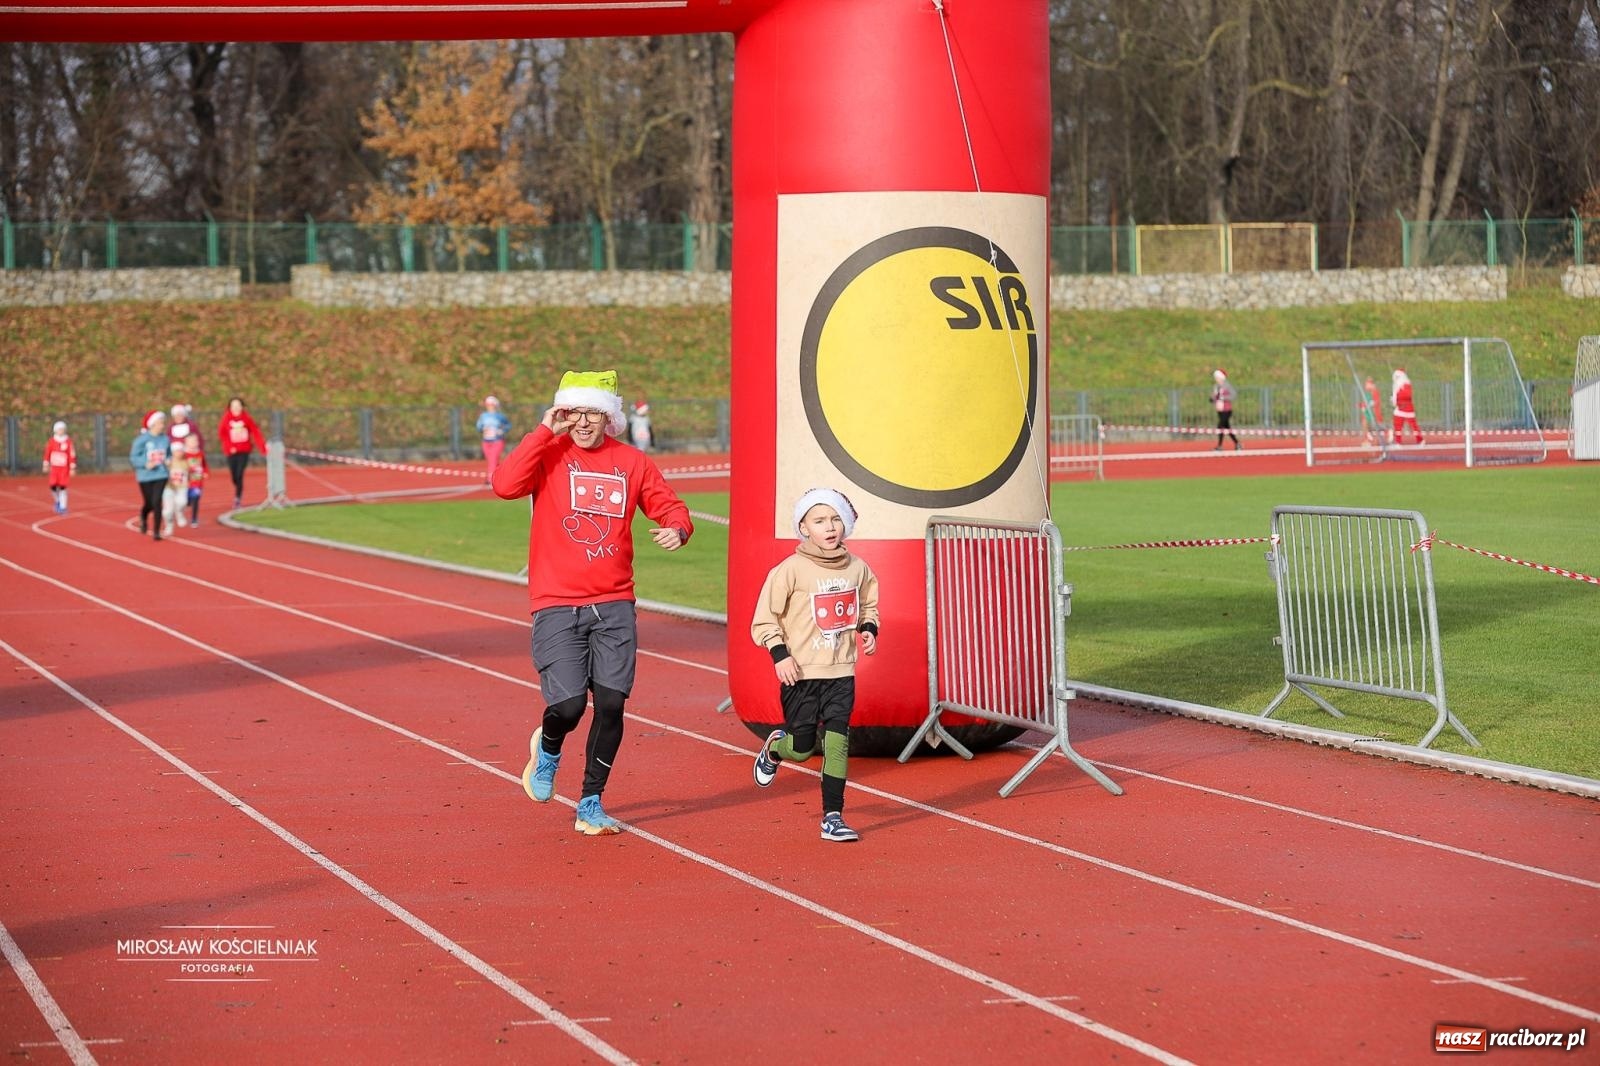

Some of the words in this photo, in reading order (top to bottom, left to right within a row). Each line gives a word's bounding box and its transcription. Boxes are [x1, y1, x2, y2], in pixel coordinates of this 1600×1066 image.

[930, 276, 1035, 330] SIR
[594, 485, 604, 501] 5
[586, 544, 619, 562] Mr.
[816, 576, 849, 592] HAPPY
[835, 600, 845, 617] 6
